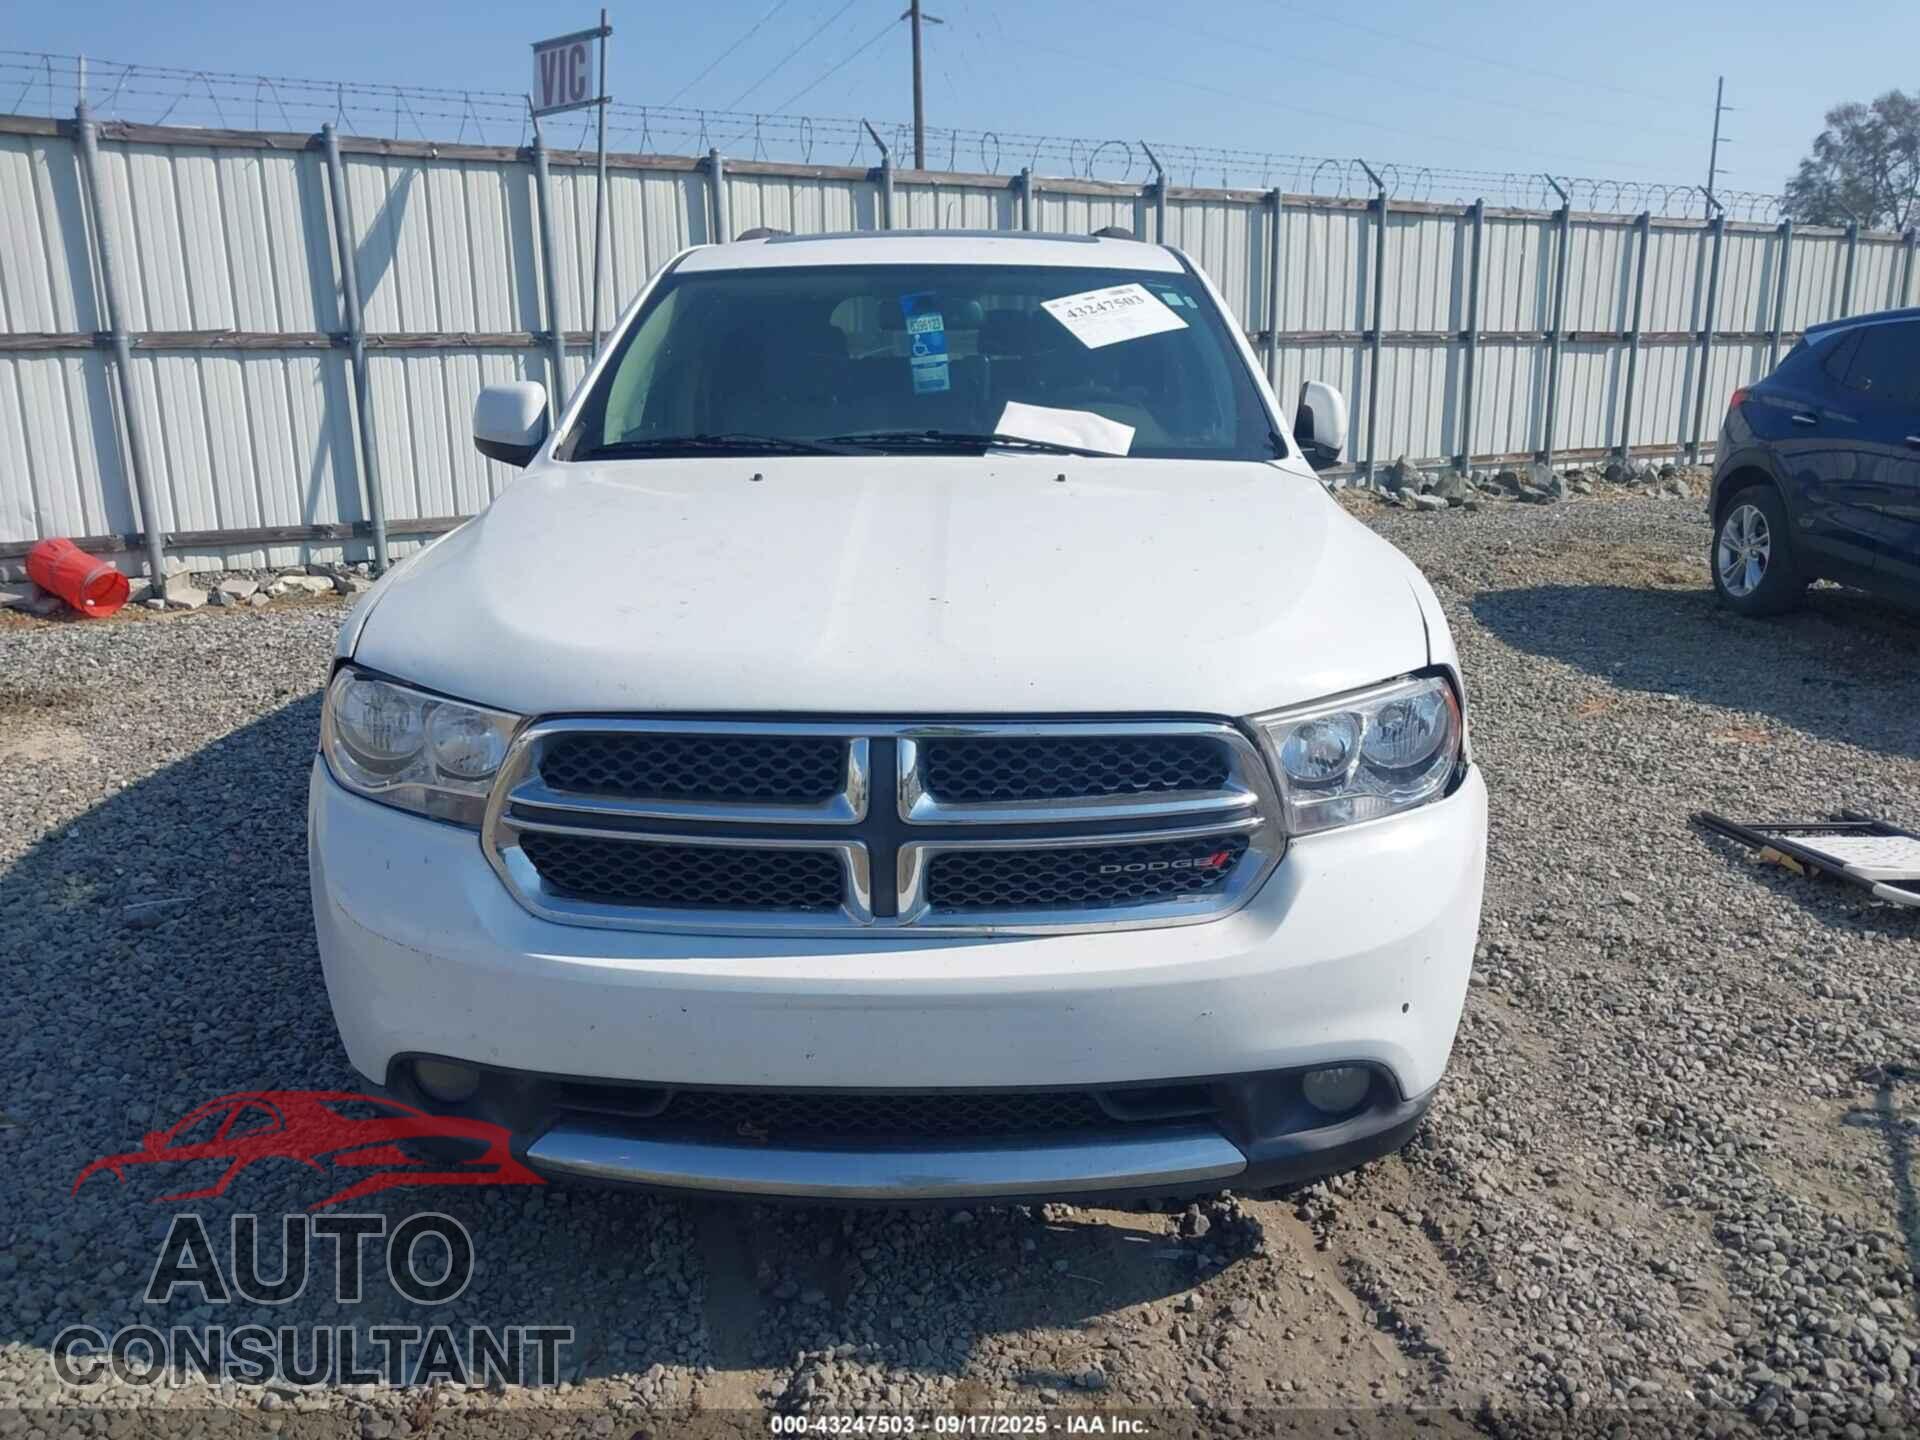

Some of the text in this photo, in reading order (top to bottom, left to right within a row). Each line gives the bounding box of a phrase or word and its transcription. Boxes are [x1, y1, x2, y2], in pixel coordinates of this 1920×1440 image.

[540, 43, 586, 107] VIC
[1066, 294, 1145, 319] 43247503
[1100, 857, 1215, 874] DODGE
